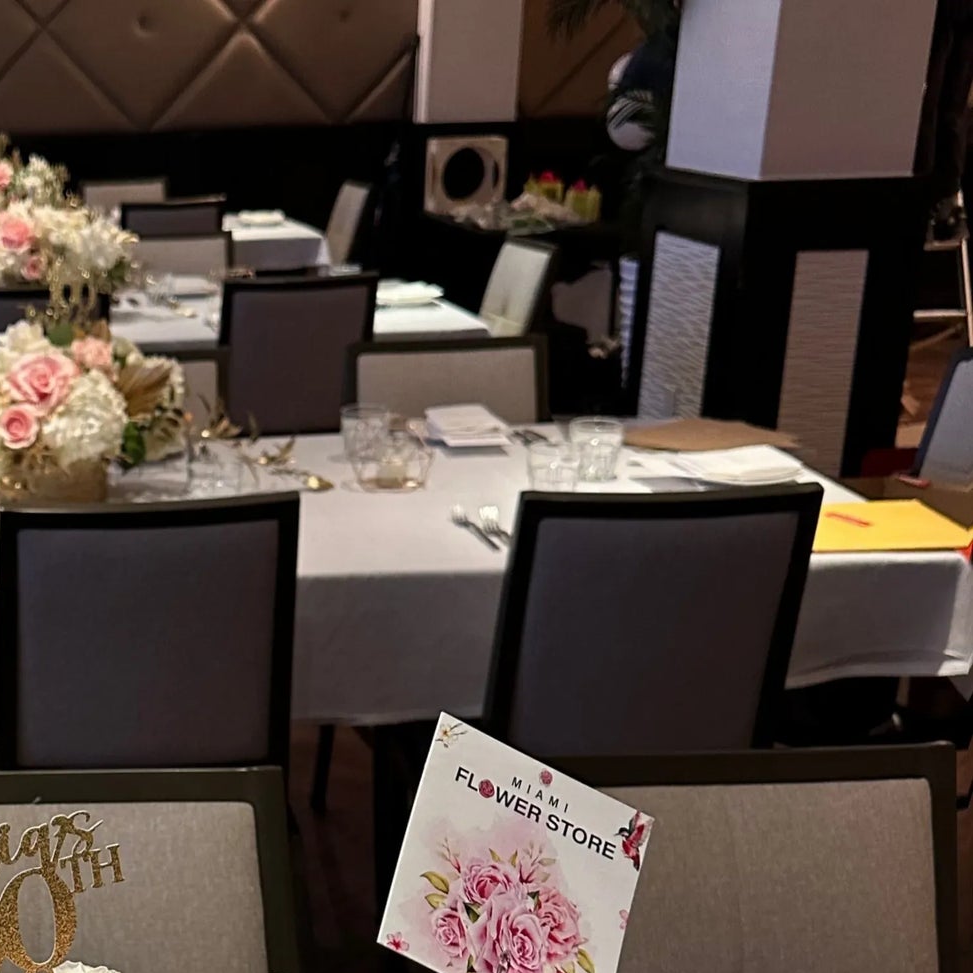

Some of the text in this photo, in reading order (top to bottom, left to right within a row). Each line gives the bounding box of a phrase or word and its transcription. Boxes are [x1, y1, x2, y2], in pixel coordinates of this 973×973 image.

[455, 766, 617, 860] FLOWER STORE
[511, 776, 569, 813] MIAMI
